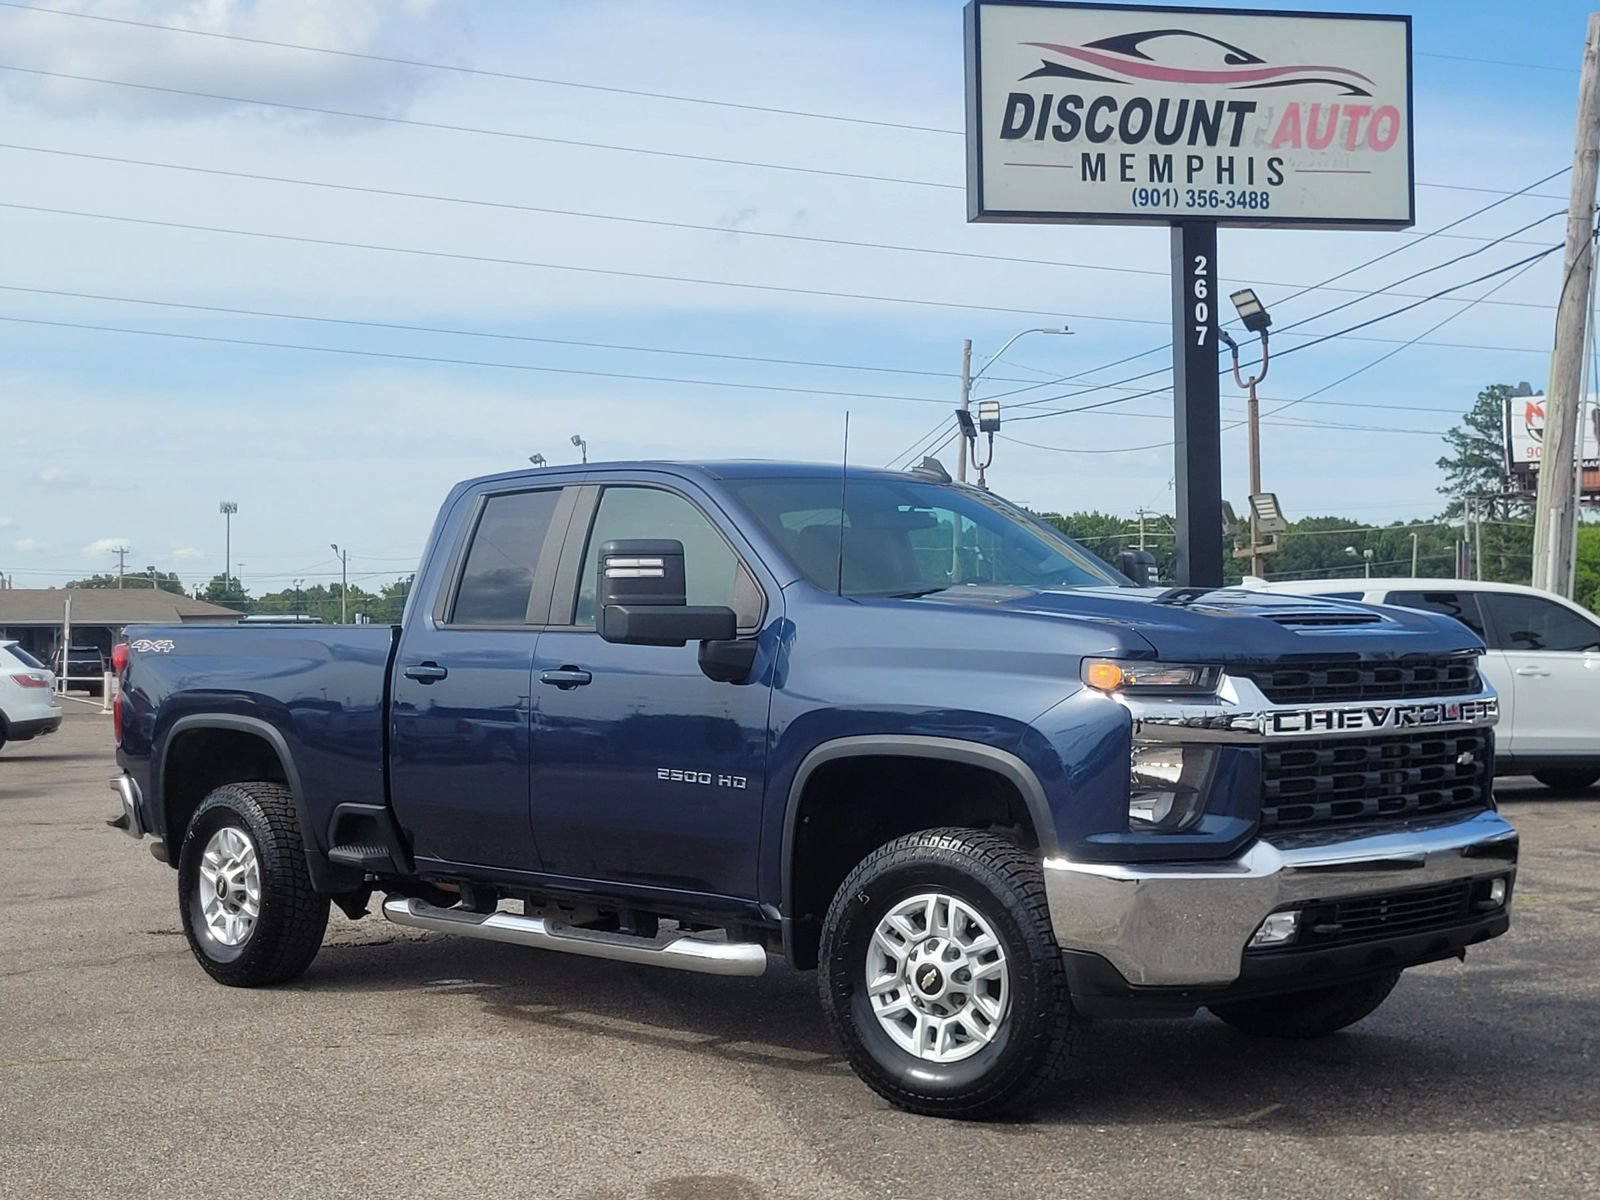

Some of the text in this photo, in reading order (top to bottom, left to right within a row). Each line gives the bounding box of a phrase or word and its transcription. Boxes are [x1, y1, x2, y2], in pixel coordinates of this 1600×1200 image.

[1000, 92, 1400, 152] DISCOUNT AUTO
[1081, 152, 1285, 186] MEMPHIS
[1131, 187, 1270, 210] (901) 356-3488
[1272, 702, 1496, 732] CHEVROLET
[657, 768, 747, 789] 2500 HD
